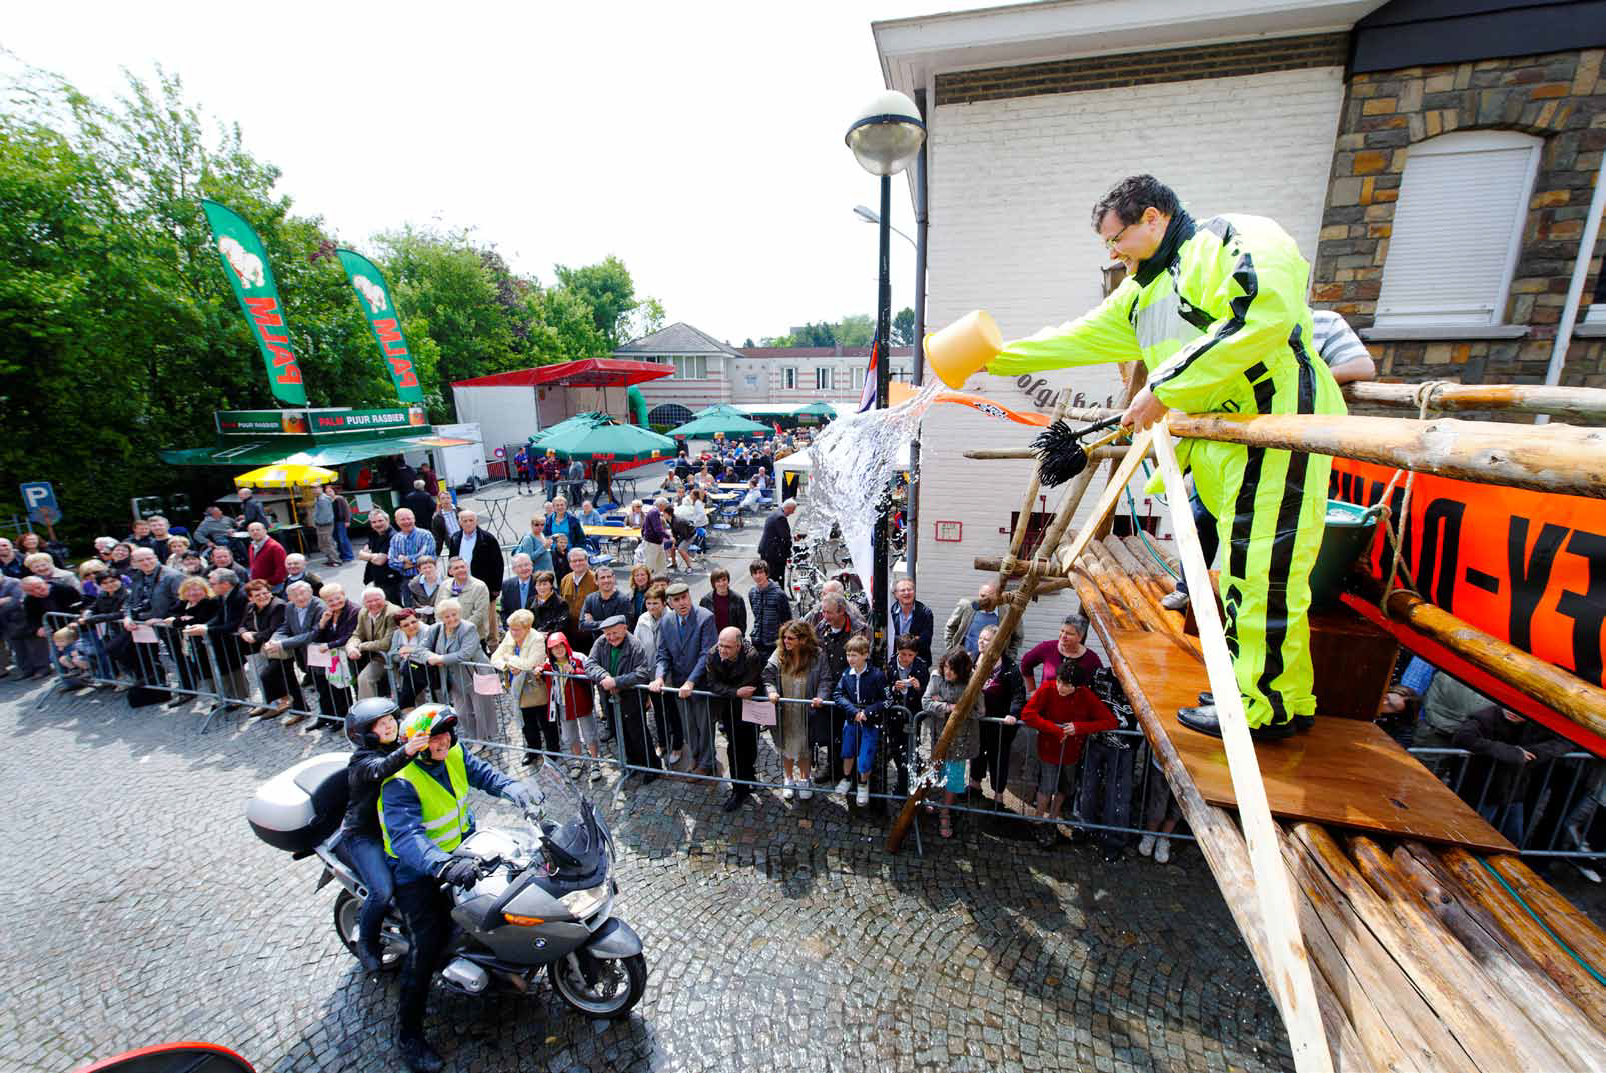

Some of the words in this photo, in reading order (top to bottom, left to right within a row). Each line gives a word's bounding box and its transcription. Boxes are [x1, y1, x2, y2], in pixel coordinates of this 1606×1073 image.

[319, 415, 344, 427] PALM
[346, 415, 370, 425] PUUR
[26, 487, 48, 507] P
